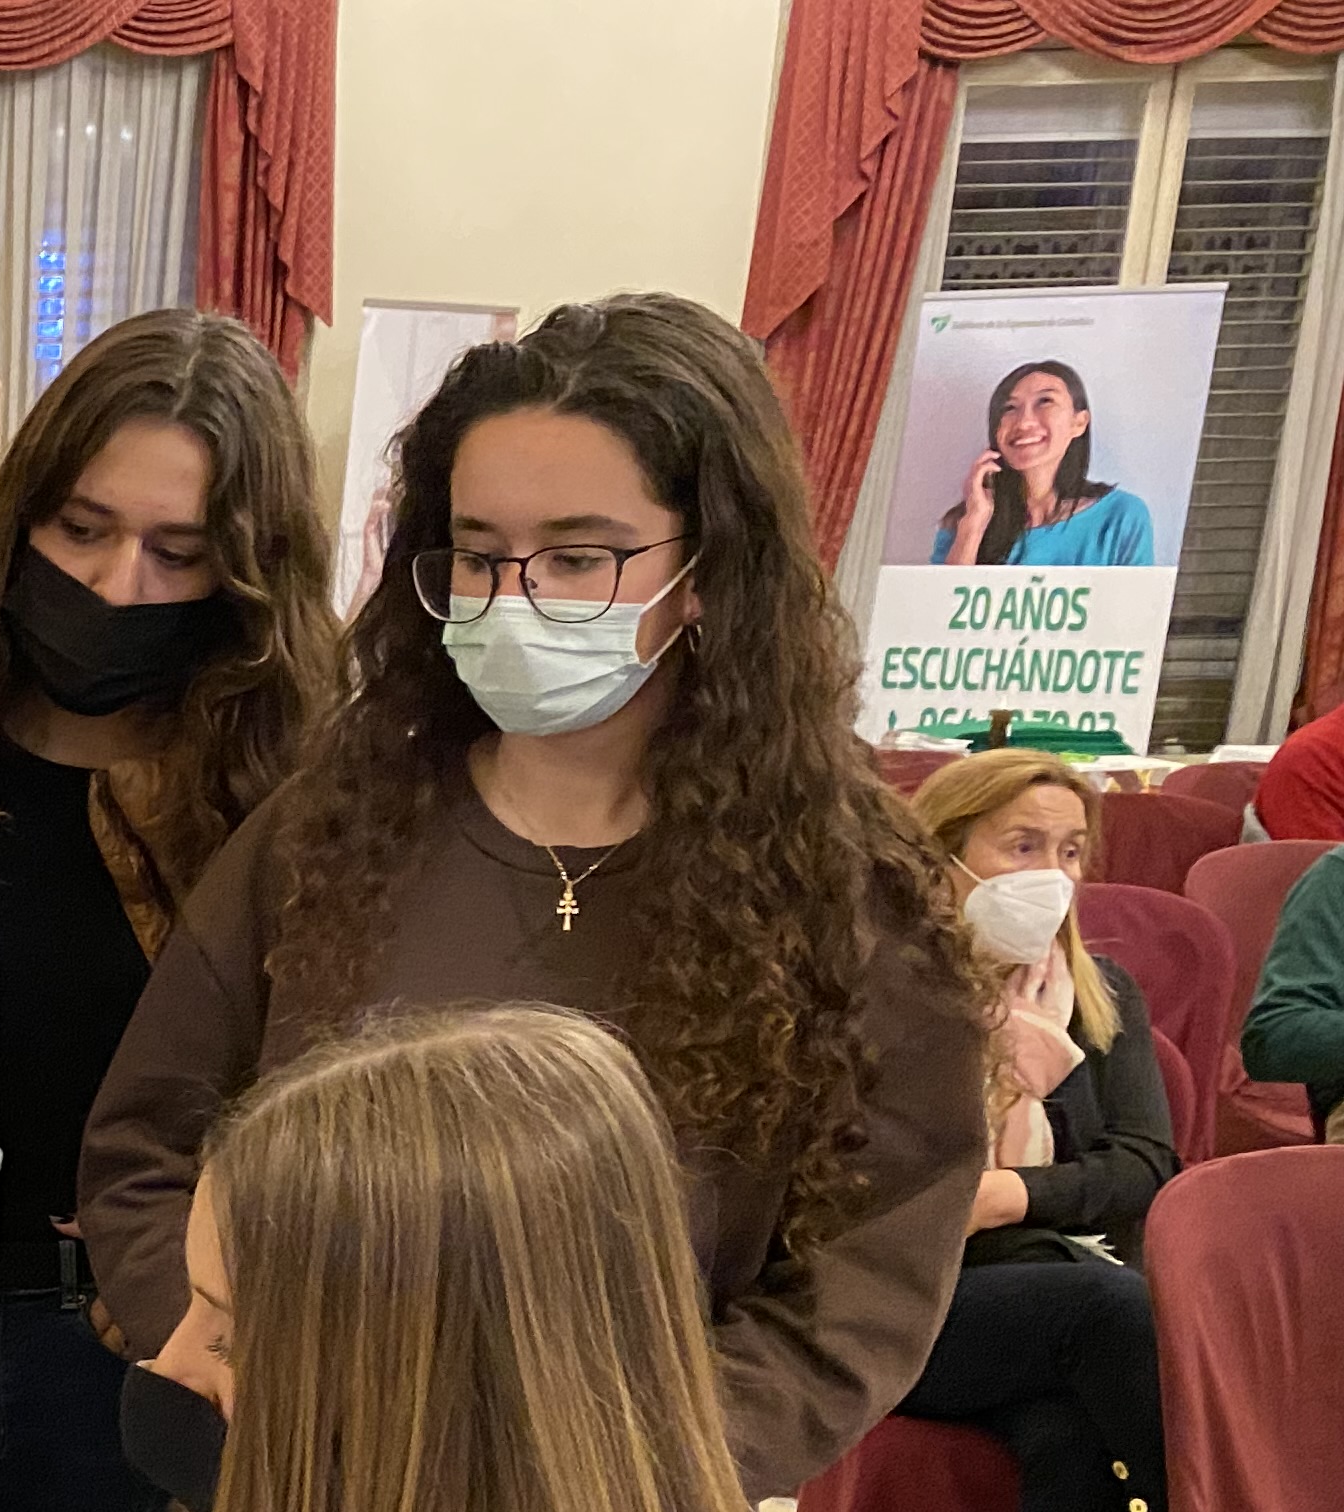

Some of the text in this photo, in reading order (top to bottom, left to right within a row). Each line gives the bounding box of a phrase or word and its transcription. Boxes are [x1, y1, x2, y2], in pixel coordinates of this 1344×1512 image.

[949, 575, 1091, 631] 20 AÑOS
[881, 636, 1144, 694] ESCUCHÁNDOTE
